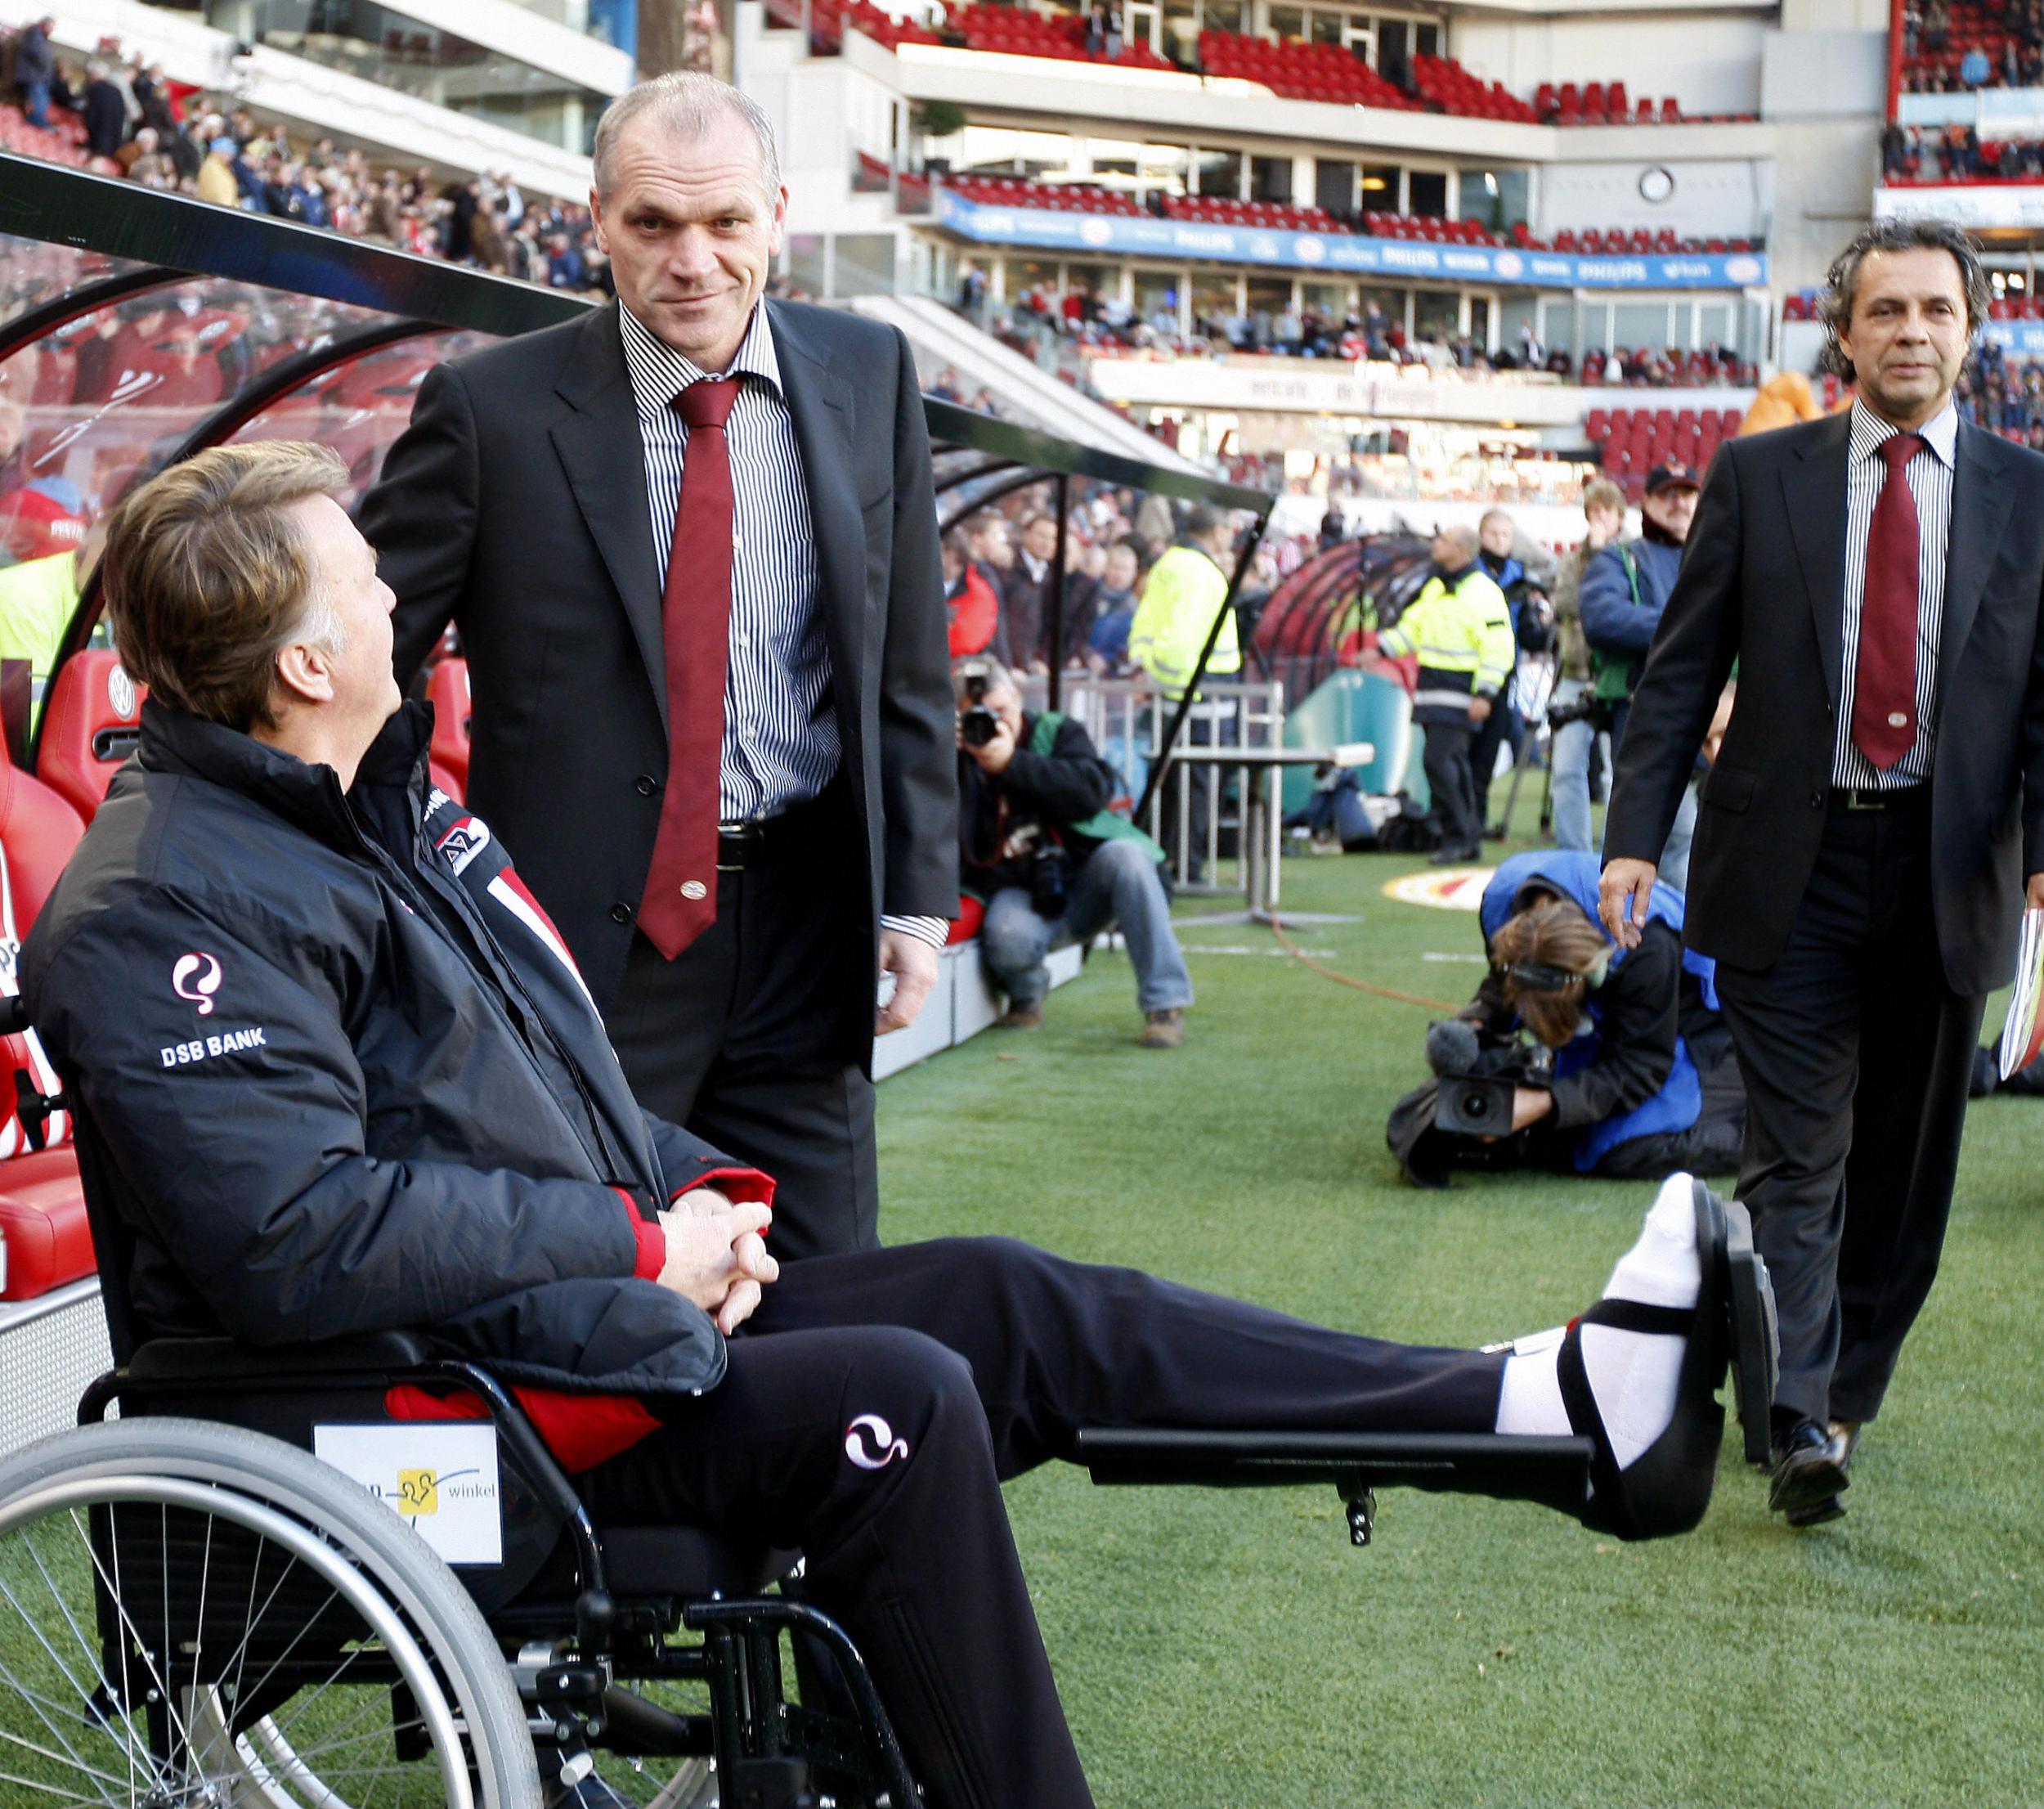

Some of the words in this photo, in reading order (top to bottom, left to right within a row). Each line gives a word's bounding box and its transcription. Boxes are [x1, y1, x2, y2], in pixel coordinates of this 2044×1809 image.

[160, 1039, 205, 1068] DSB
[205, 1026, 267, 1057] BANK
[449, 1483, 495, 1499] winkel
